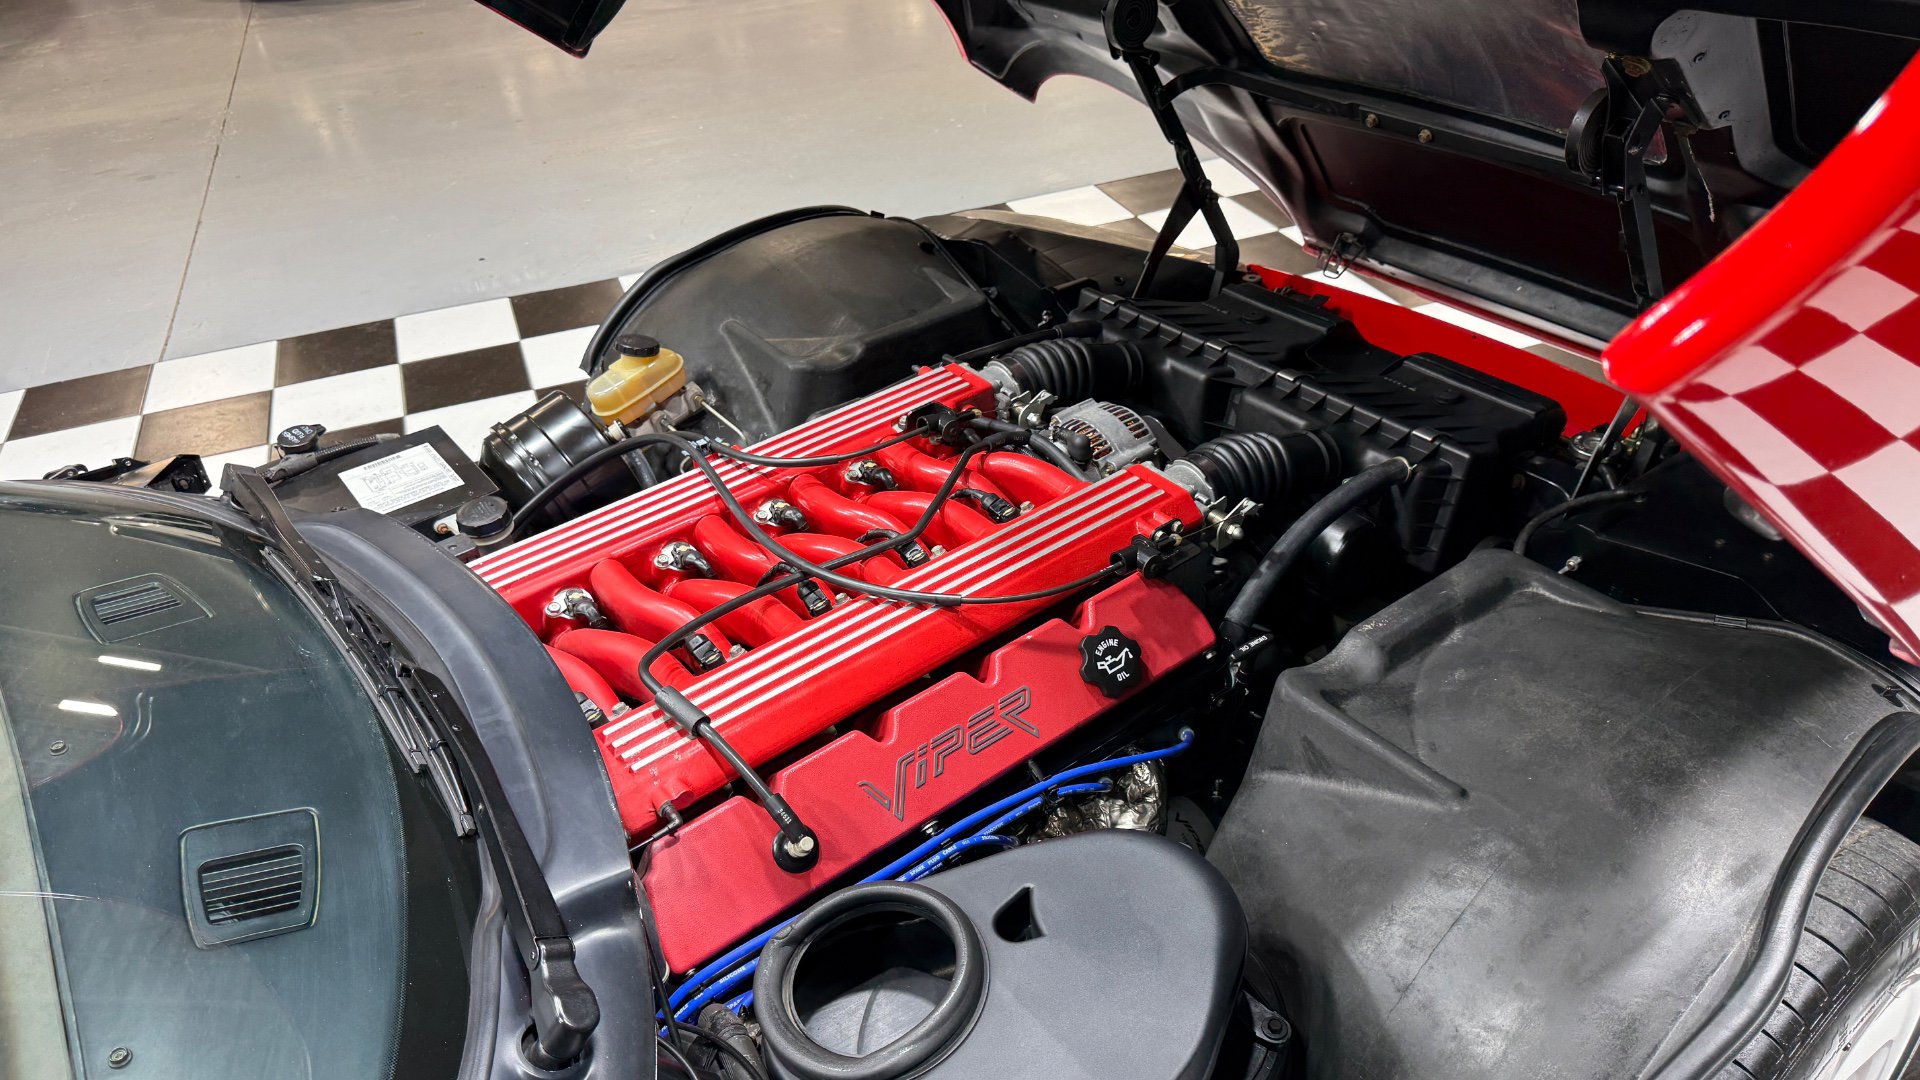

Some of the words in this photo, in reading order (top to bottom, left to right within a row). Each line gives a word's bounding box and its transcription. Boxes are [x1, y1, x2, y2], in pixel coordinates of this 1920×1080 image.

[1095, 638, 1119, 656] ENGINE
[1239, 644, 1250, 652] OIL
[1249, 635, 1268, 648] ENGINE
[1116, 670, 1130, 681] OIL
[909, 864, 926, 877] SPARK
[927, 854, 941, 866] PLUG
[942, 844, 957, 856] CABLE
[719, 965, 747, 984] SILICONE
